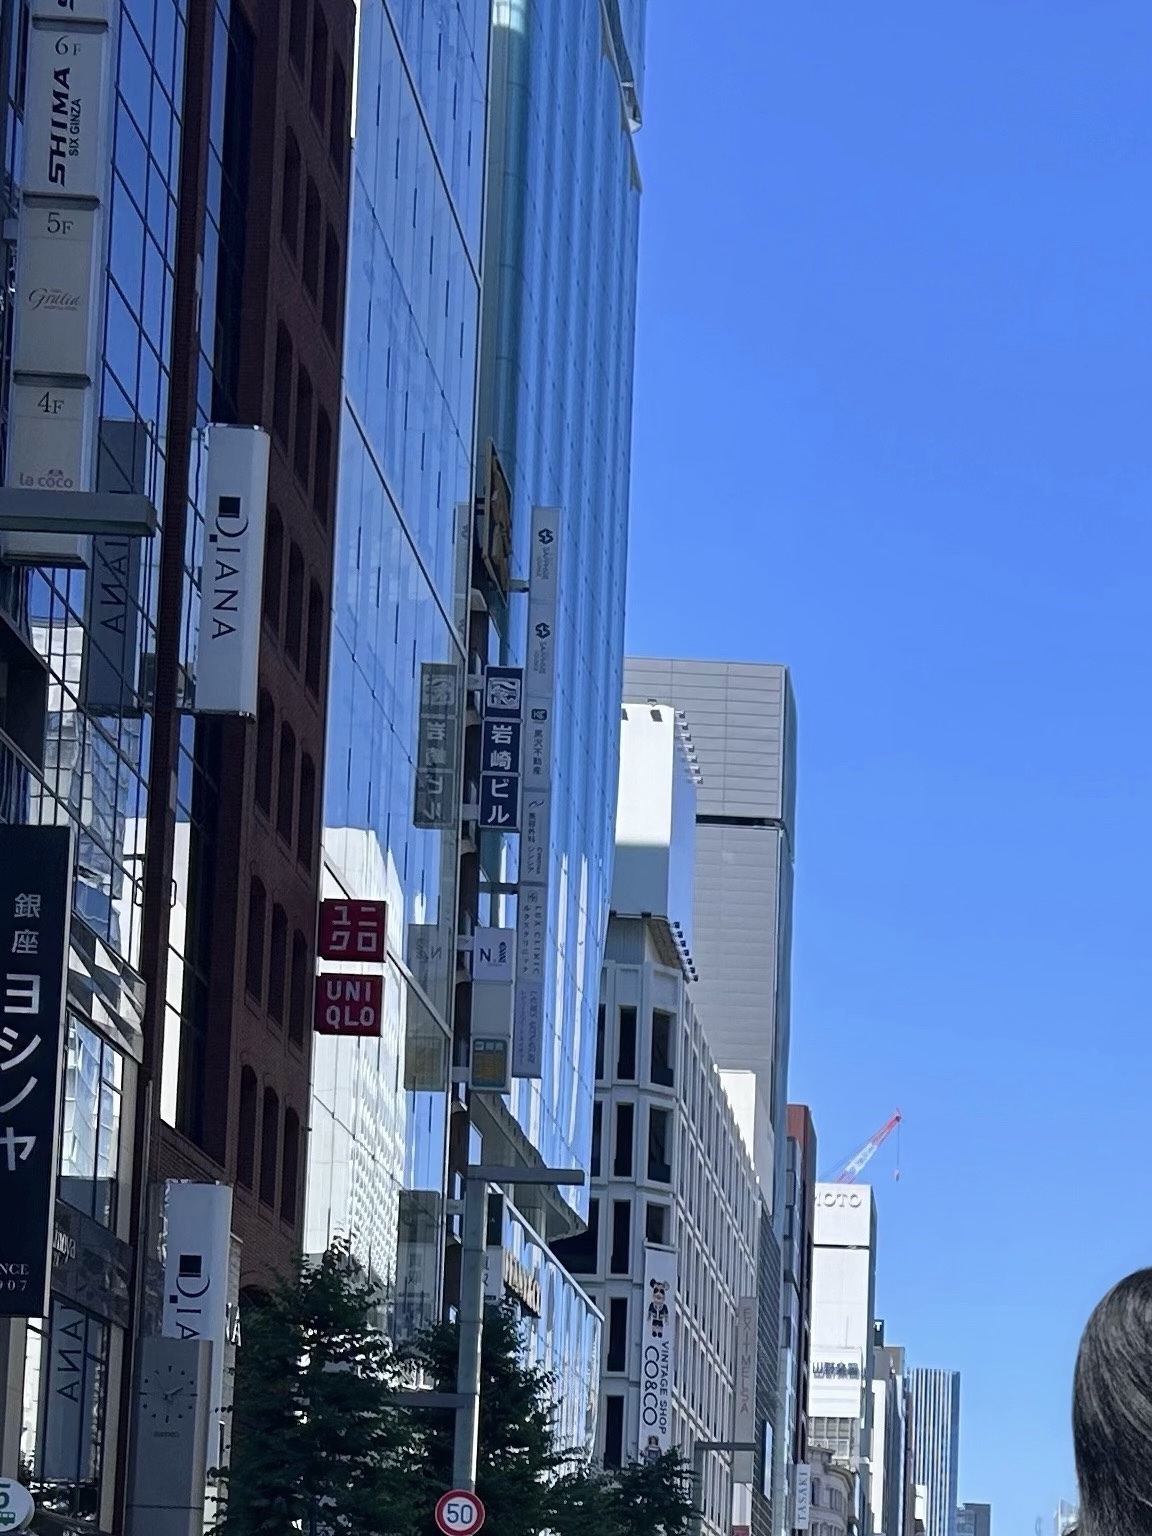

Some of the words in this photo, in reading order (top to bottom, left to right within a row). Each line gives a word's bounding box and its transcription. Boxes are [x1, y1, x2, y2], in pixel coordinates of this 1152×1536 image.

[49, 66, 71, 188] SHIMA
[70, 98, 82, 134] GINZA
[69, 132, 80, 157] SIX
[47, 211, 75, 235] 5F
[37, 391, 65, 415] 4F
[209, 496, 249, 640] DIANA
[487, 724, 514, 824] 岩崎ビル
[326, 980, 371, 1002] UNI
[326, 1004, 375, 1030] QLO
[642, 1345, 660, 1426] CO&CO
[659, 1340, 670, 1396] VINTAGE
[658, 1399, 668, 1435] SHOP
[446, 1503, 473, 1525] 50
[798, 1472, 808, 1523] TASAKI
